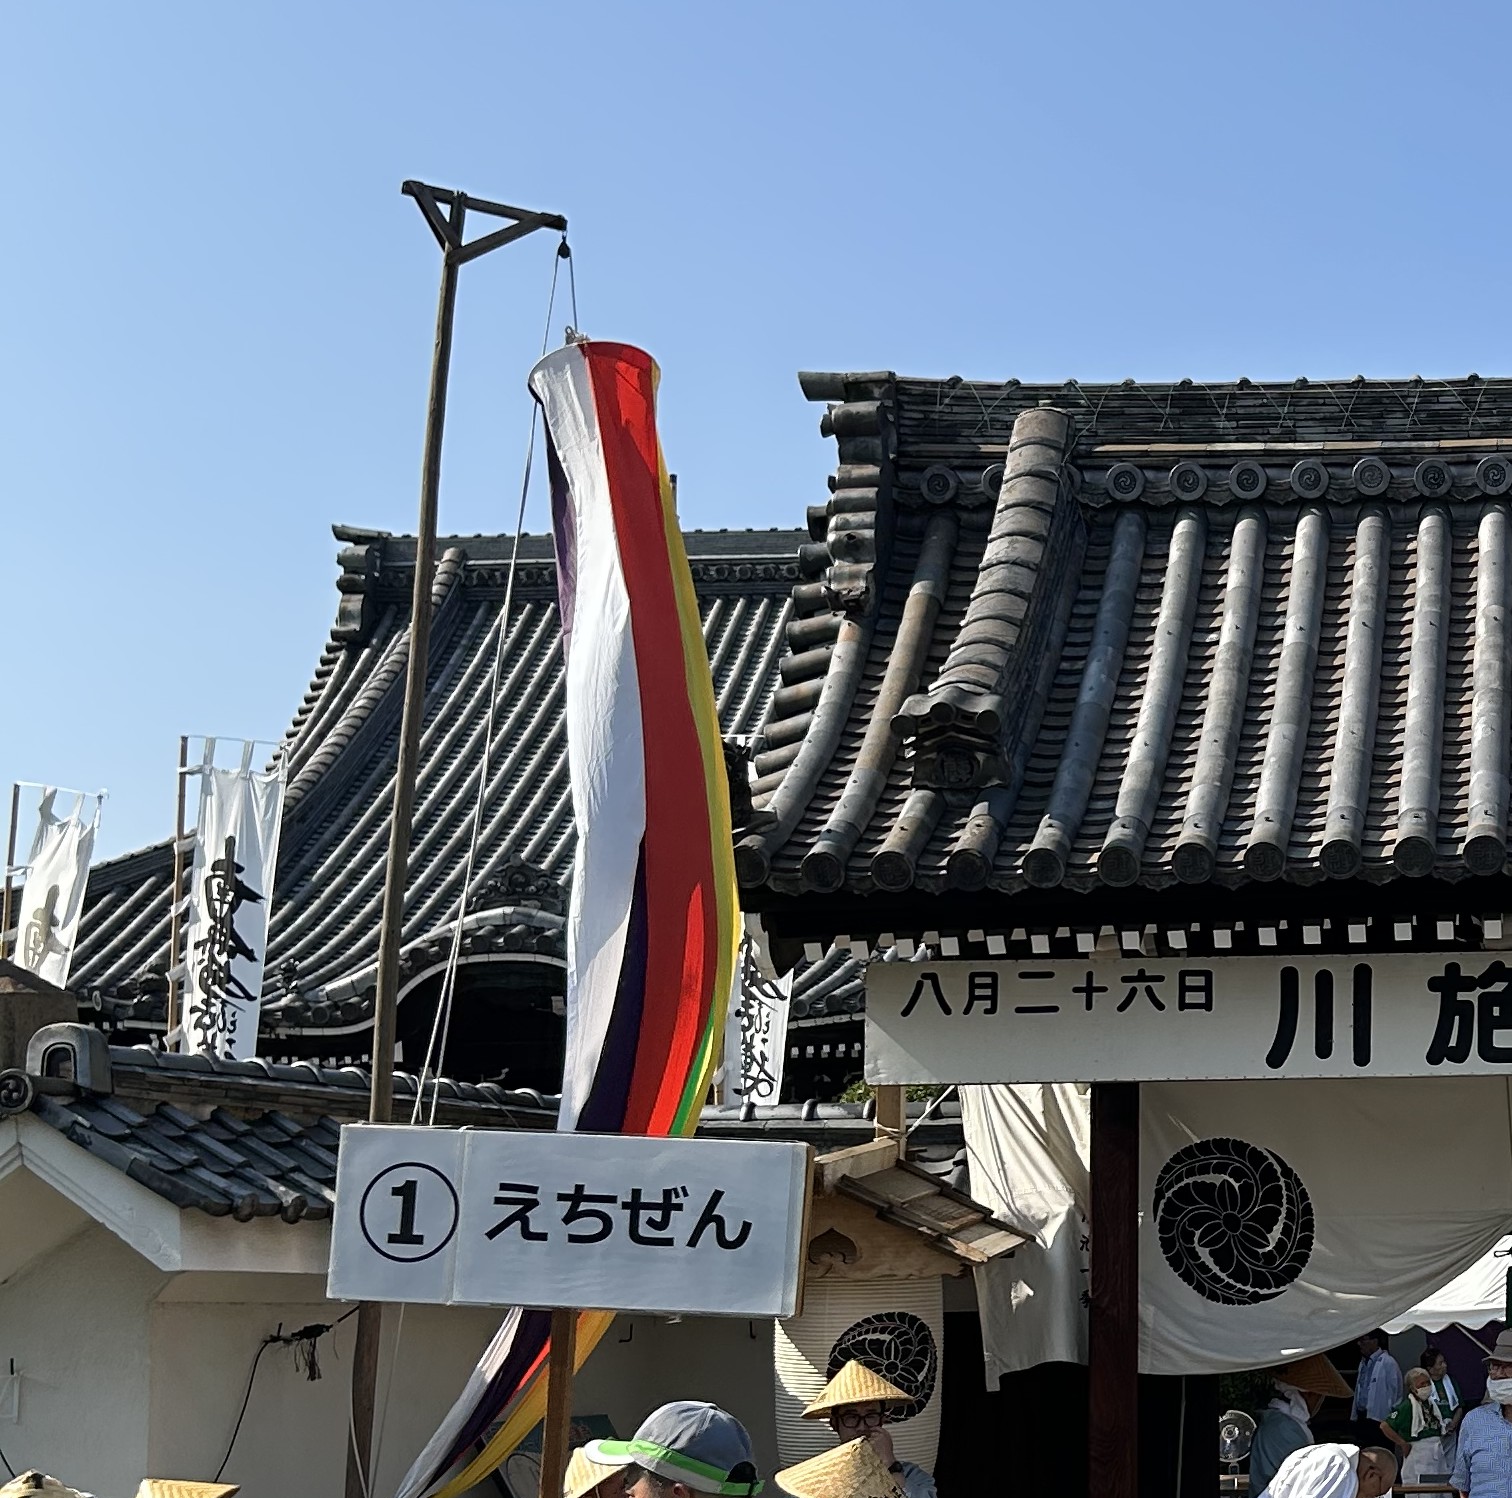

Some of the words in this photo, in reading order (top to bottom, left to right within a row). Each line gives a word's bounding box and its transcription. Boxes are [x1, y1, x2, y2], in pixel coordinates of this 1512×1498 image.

[900, 967, 1214, 1017] 八月二十六日
[484, 1182, 753, 1251] えちぜん
